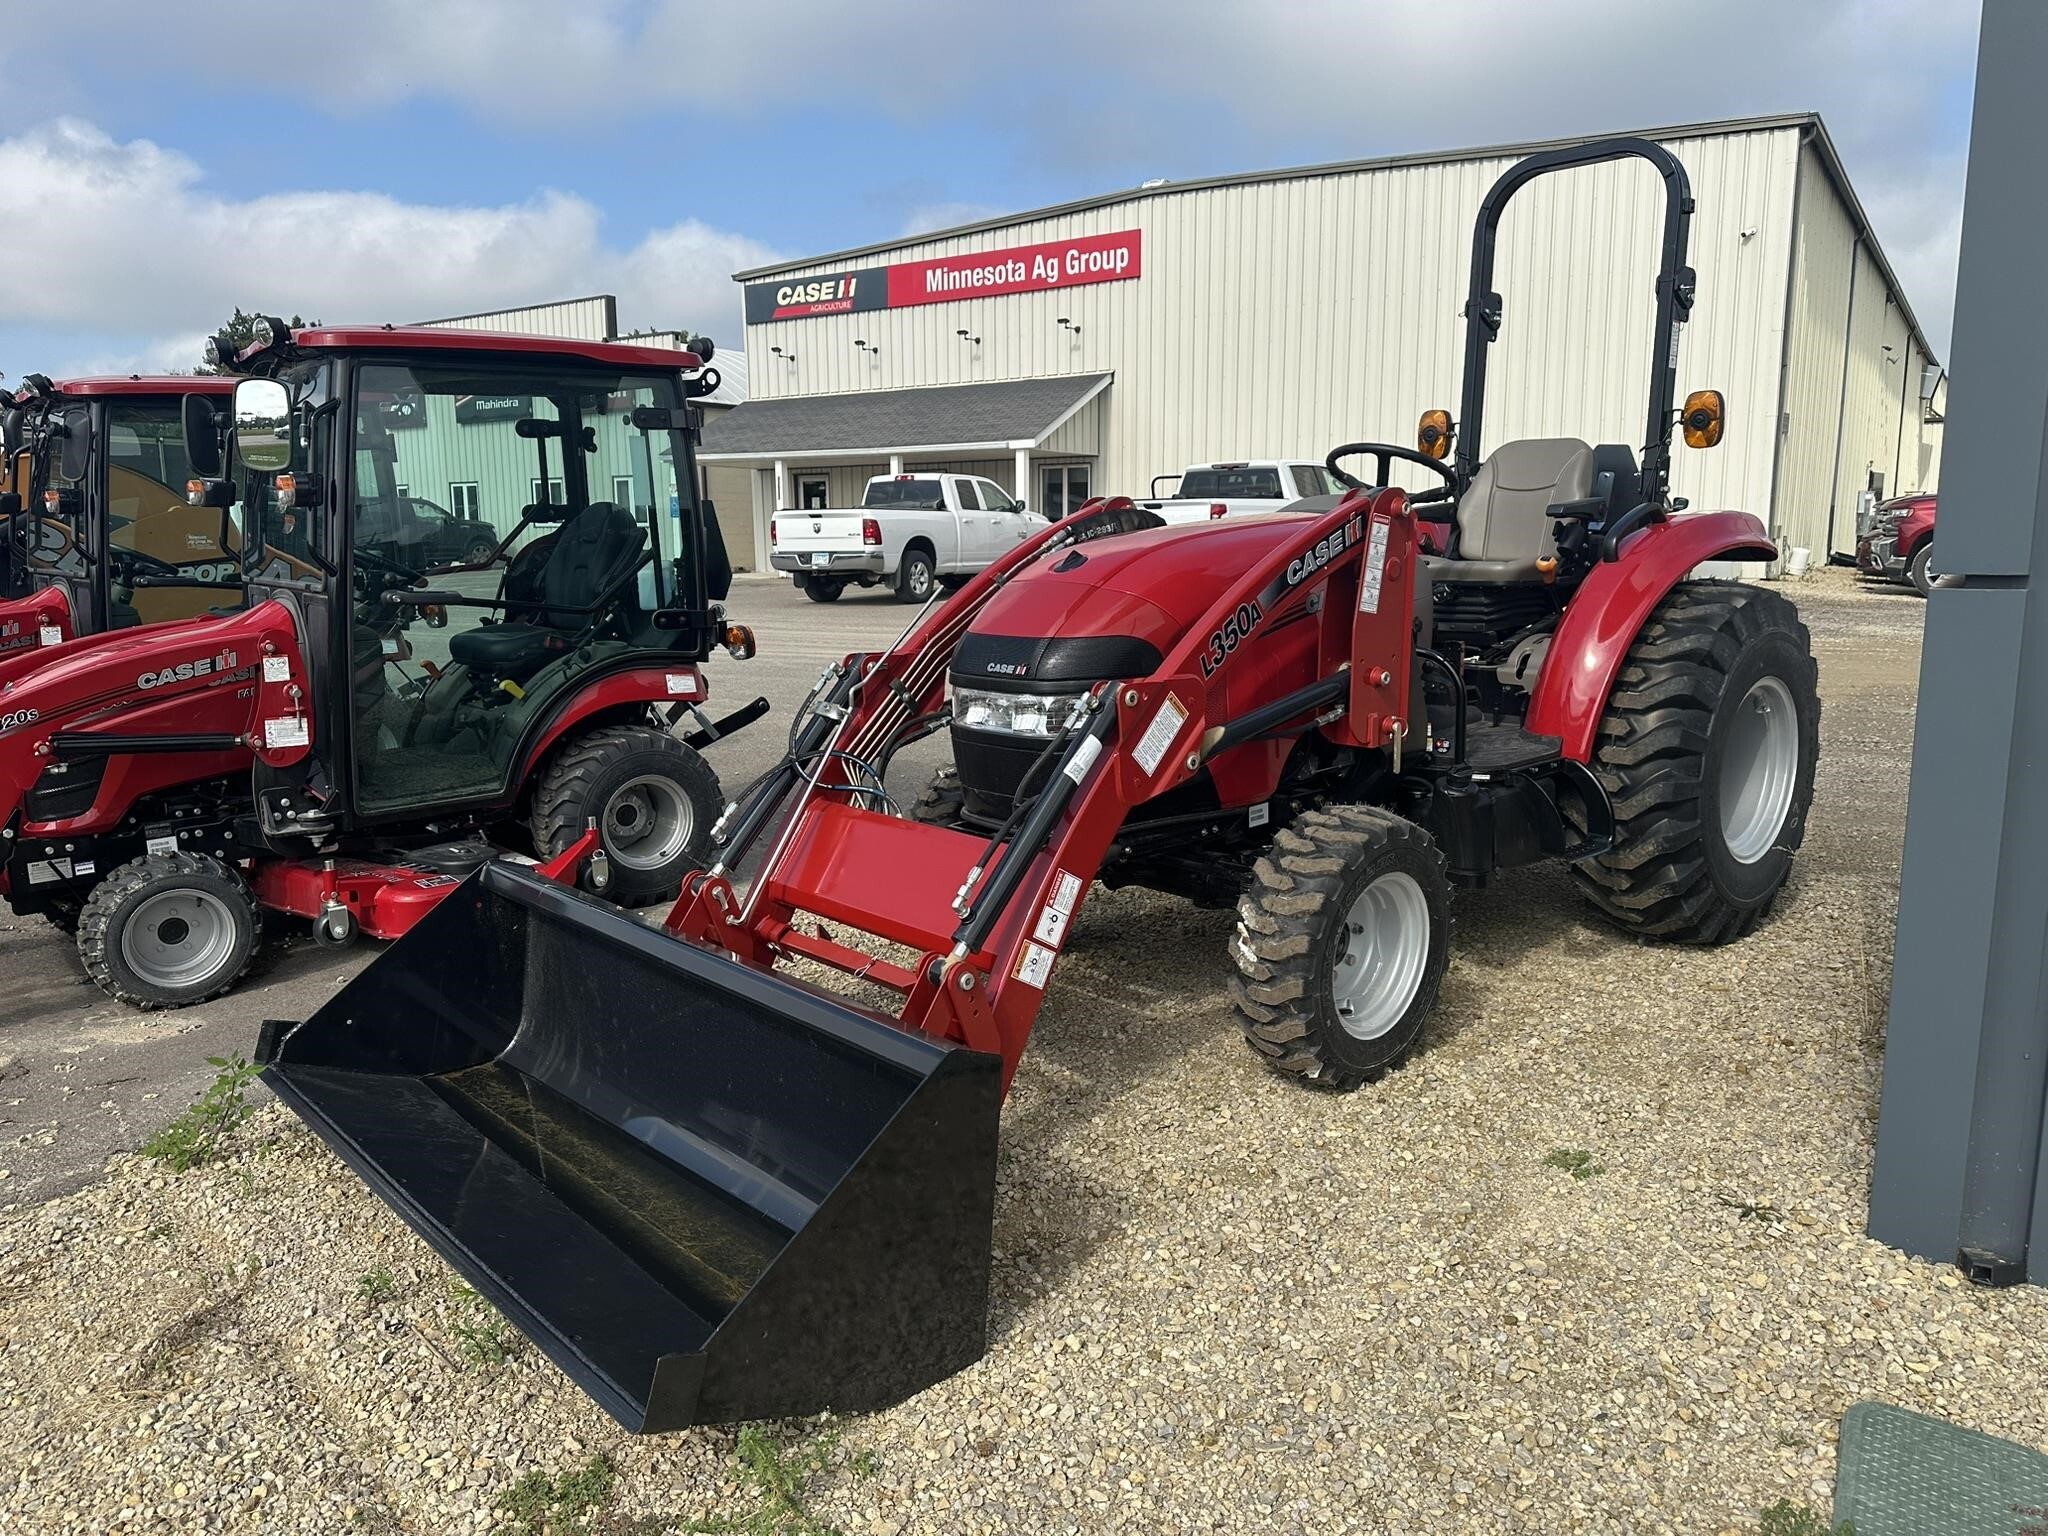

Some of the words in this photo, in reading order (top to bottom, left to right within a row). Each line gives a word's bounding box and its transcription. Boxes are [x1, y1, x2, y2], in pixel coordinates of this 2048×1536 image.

[926, 258, 1025, 293] Minnesota
[1032, 254, 1059, 282] Ag
[1065, 247, 1129, 275] Group
[777, 281, 835, 305] CASE
[810, 300, 851, 312] AGRICULTURE
[476, 398, 519, 410] Mahindra
[1286, 530, 1343, 585] CASE
[1200, 600, 1264, 680] L350A
[137, 658, 211, 690] CASE
[986, 662, 1015, 674] CASE
[0, 709, 39, 731] 20s
